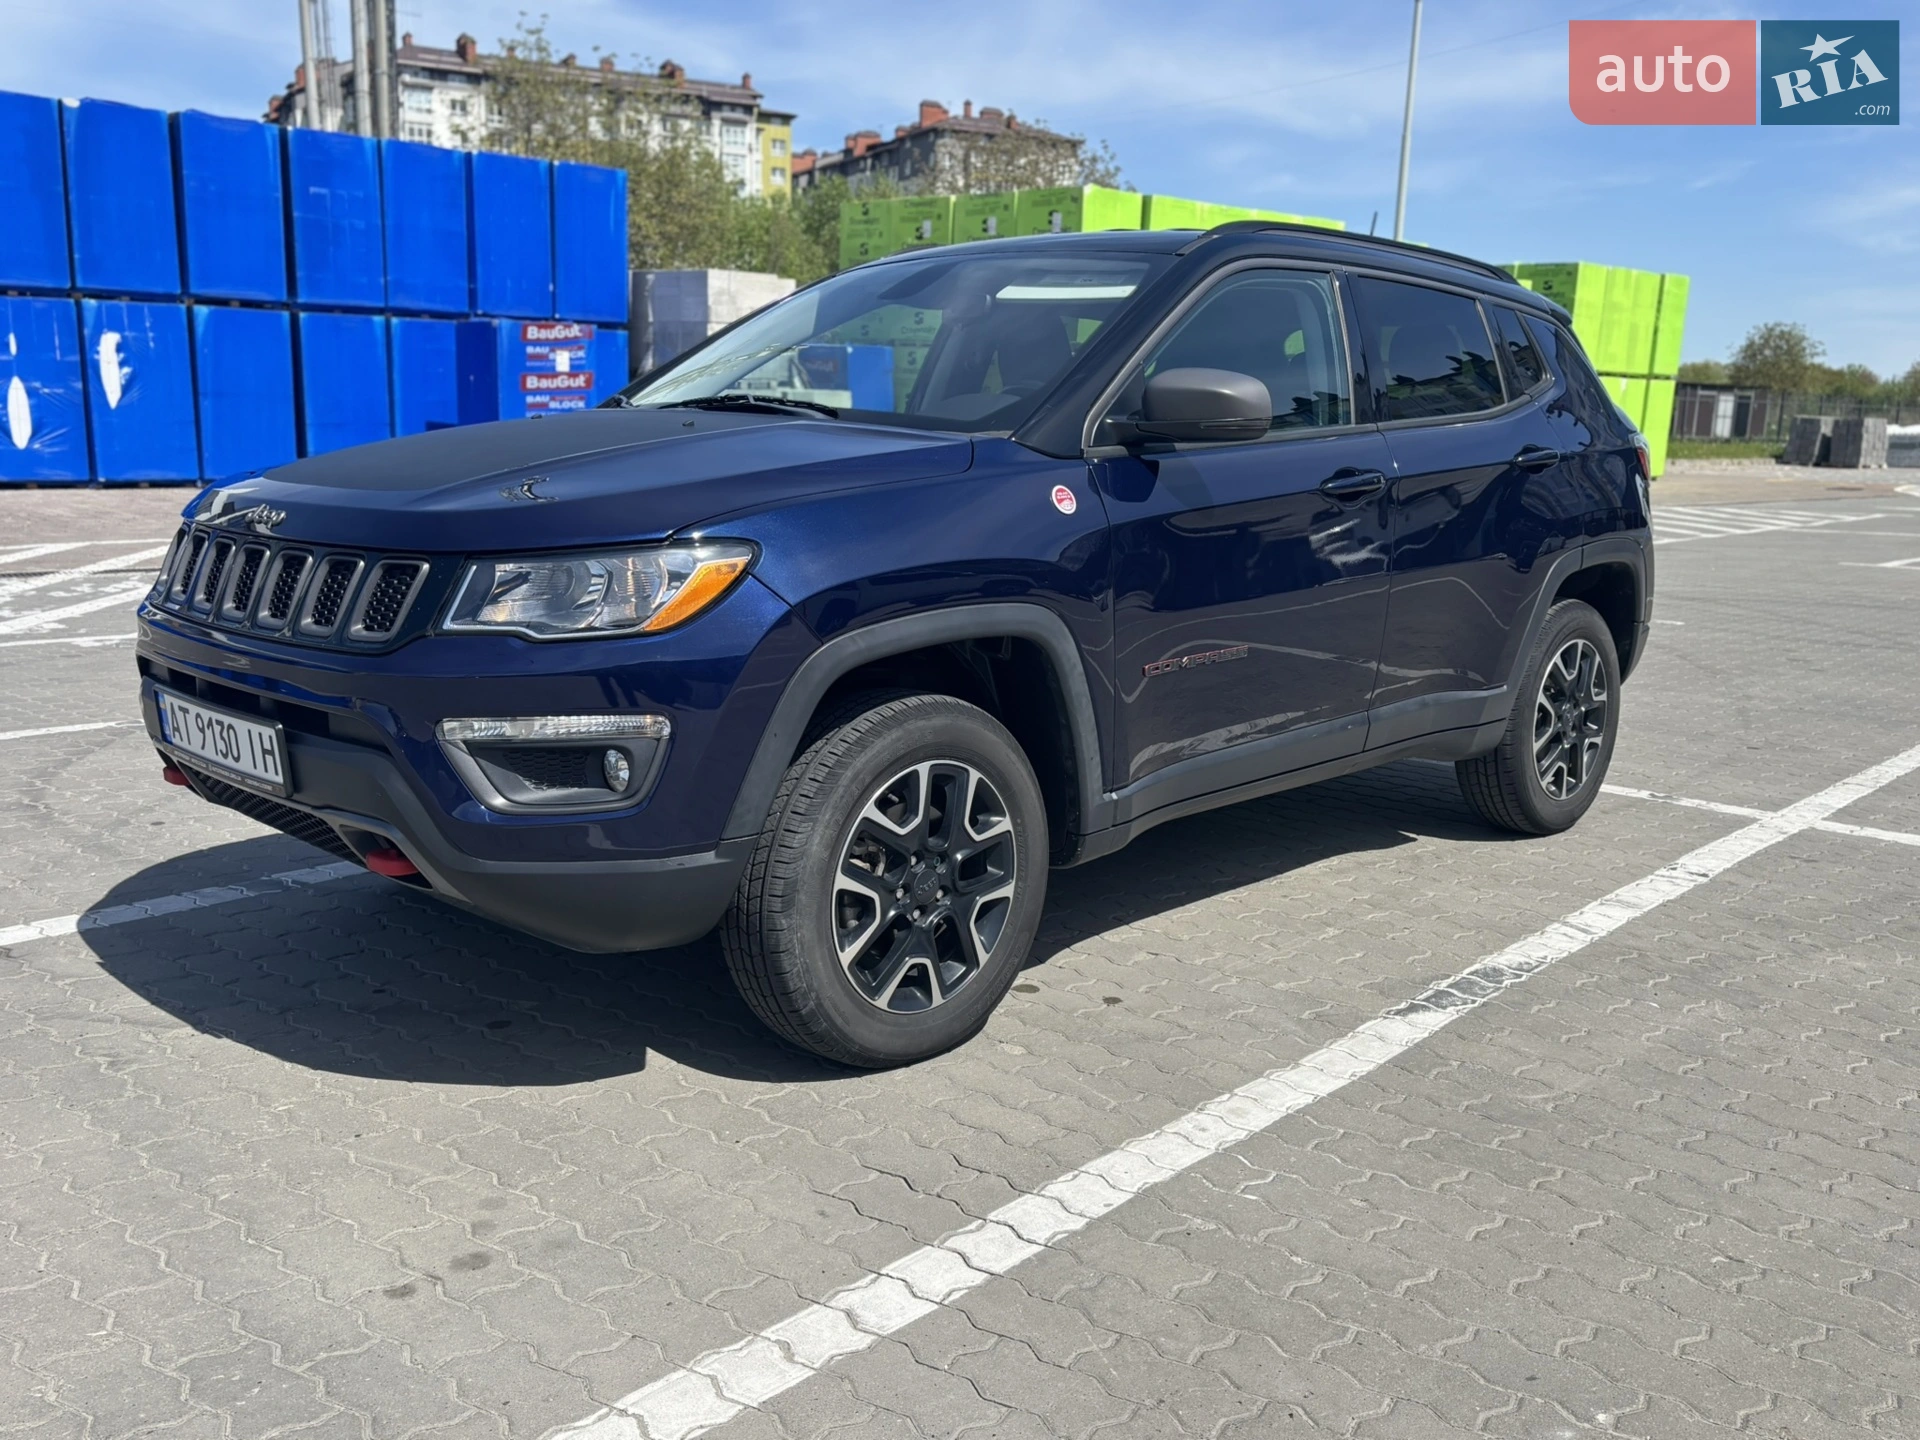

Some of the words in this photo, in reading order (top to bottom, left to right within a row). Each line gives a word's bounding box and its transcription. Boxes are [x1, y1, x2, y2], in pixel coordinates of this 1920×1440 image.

[526, 323, 583, 340] BauGut
[526, 345, 550, 354] BAU
[549, 350, 586, 360] BCK
[526, 374, 587, 389] BauGut
[526, 395, 550, 404] BAU
[549, 401, 586, 409] BLOCK
[170, 702, 192, 746] AT
[195, 712, 241, 763] 9130
[247, 728, 279, 776] IH
